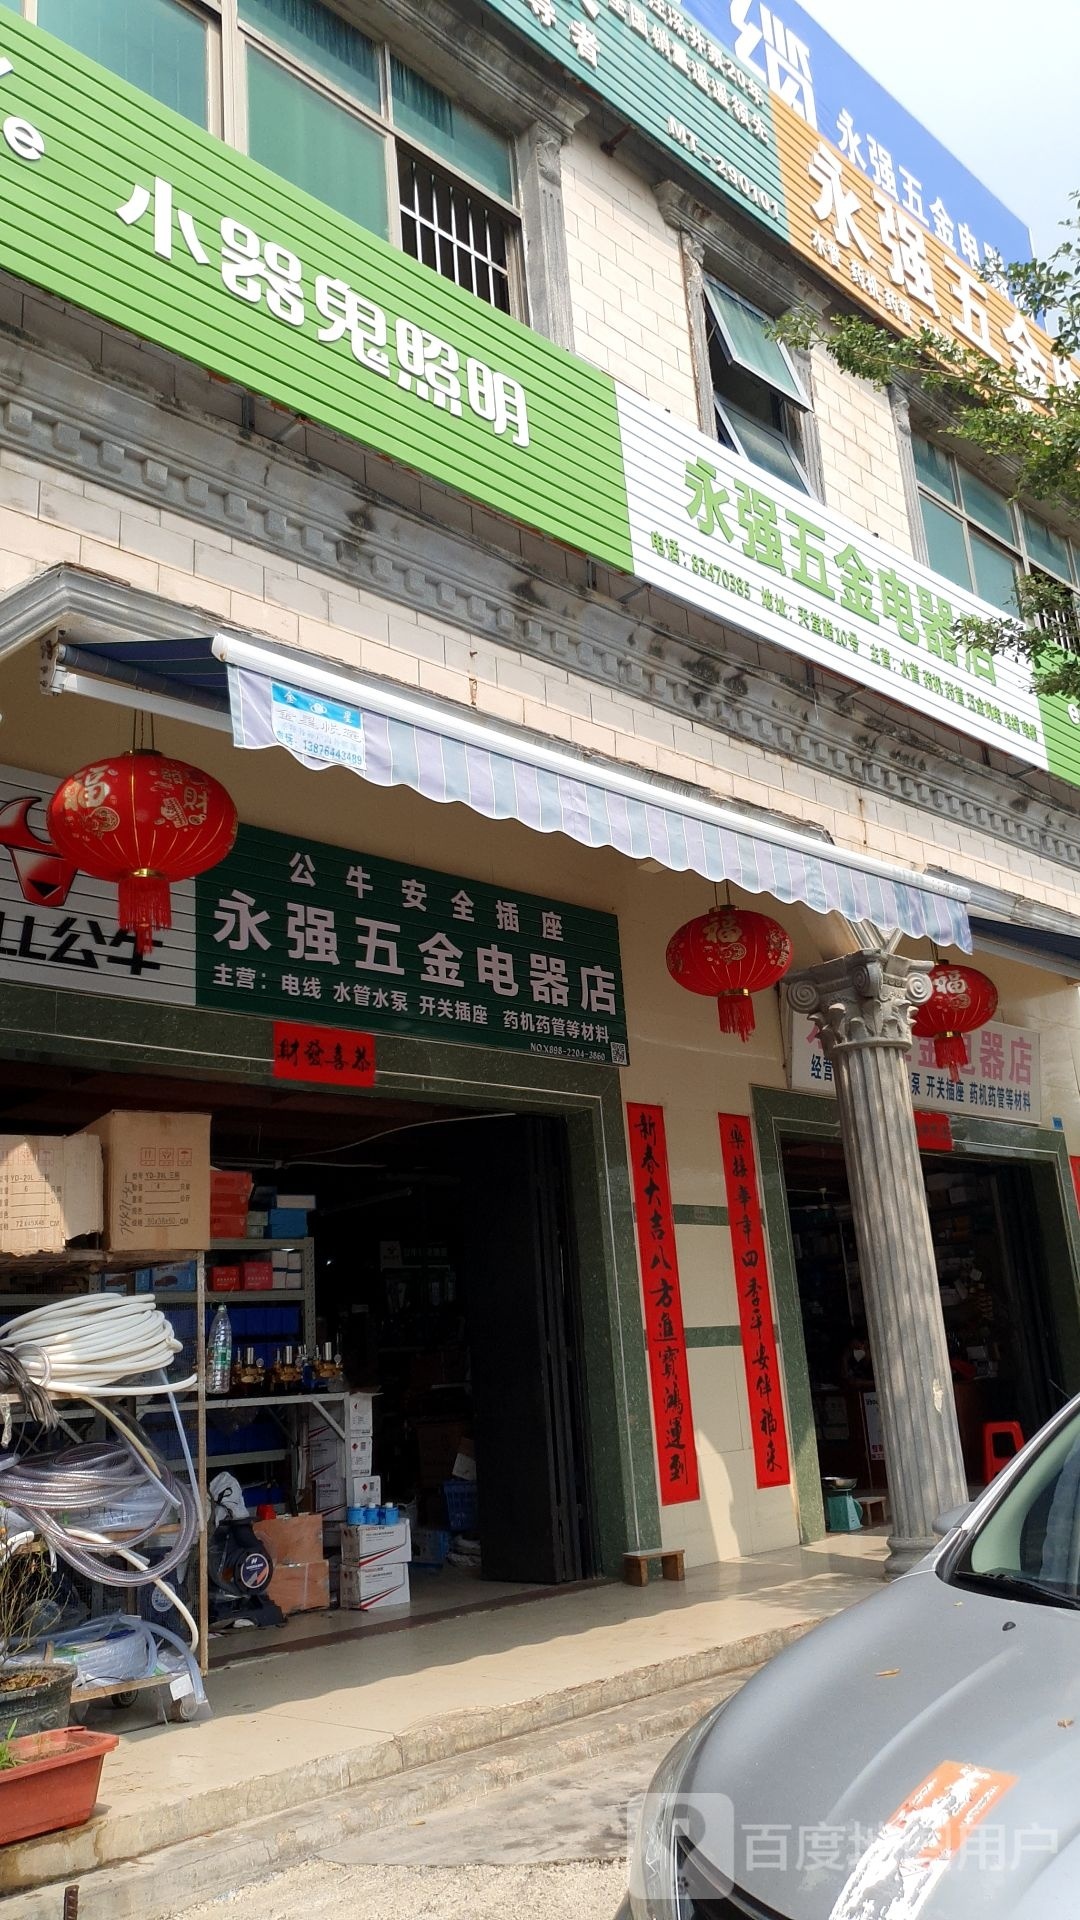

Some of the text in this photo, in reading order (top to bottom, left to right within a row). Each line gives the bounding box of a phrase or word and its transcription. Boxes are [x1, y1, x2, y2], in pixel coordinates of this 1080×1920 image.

[836, 107, 1034, 322] 永强五金电
[289, 852, 564, 942] 公牛安全插座
[213, 889, 616, 1016] 永强五金电器店
[333, 982, 409, 1012] 水管水泵
[419, 995, 488, 1026] 开关插座
[503, 1010, 609, 1044] 药机药管等材料
